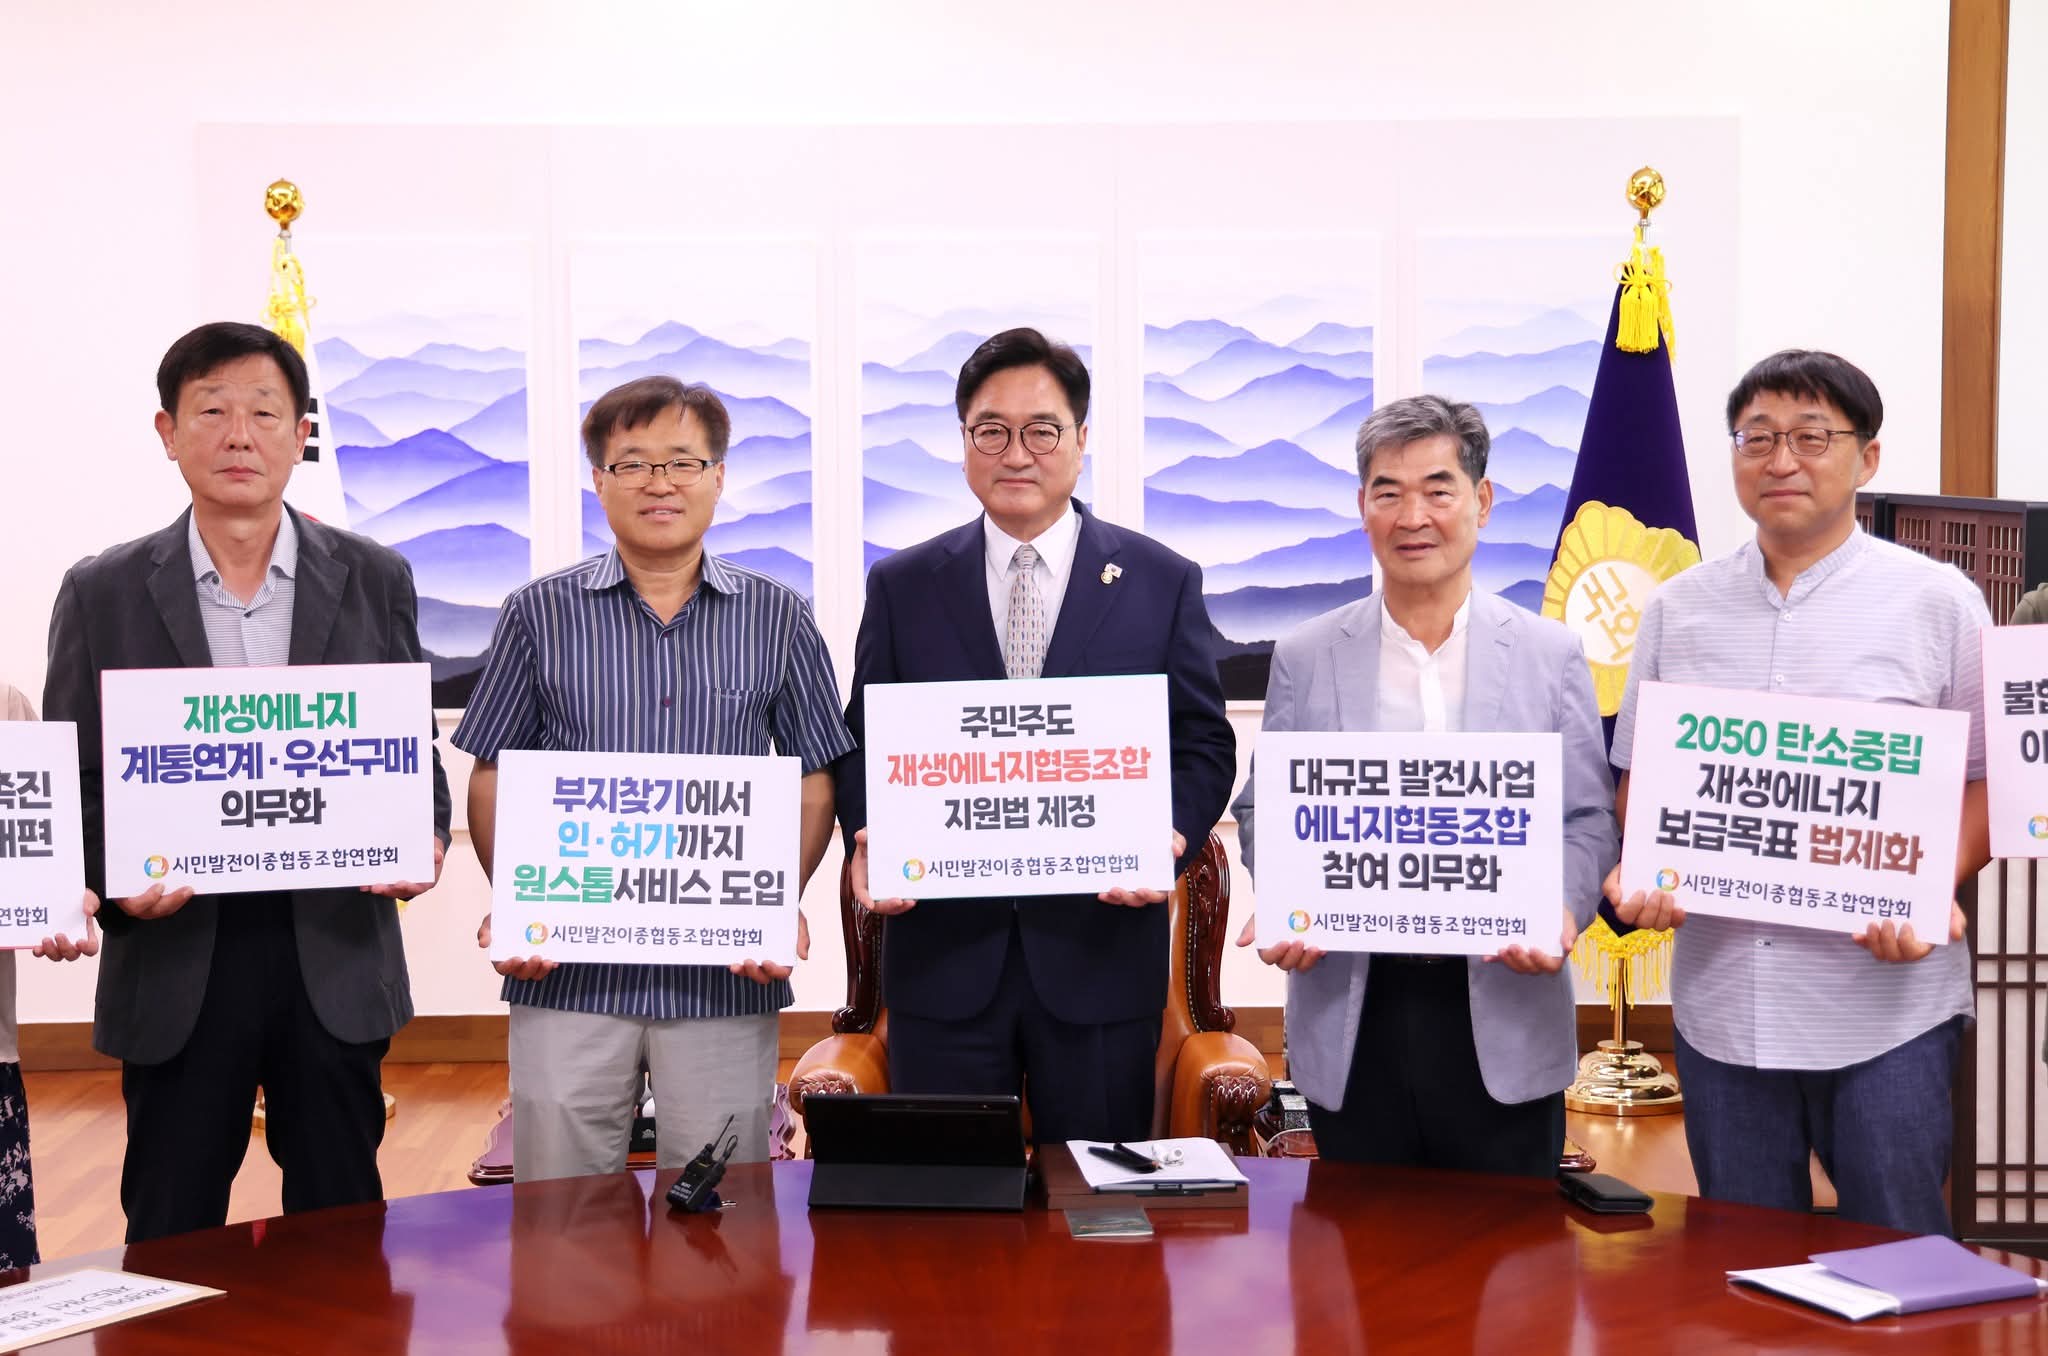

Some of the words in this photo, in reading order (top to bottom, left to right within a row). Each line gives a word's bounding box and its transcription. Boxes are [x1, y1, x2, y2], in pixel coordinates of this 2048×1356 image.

[184, 691, 357, 733] 재생에너지
[961, 704, 1074, 738] 주민주도
[1675, 713, 1767, 757] 2050
[1775, 722, 1923, 775] 탄소중립
[888, 747, 1150, 786] 재생에너지협동조합
[1290, 759, 1390, 796] 대규모
[1399, 760, 1534, 798] 발전사업
[221, 787, 326, 827] 의무화
[553, 777, 751, 816] 부지찾기에서
[1697, 763, 1881, 820] 재생에너지
[945, 797, 1029, 830] 지원법
[1037, 795, 1095, 828] 제정
[1295, 805, 1531, 846] 에너지협동조합
[1656, 806, 1798, 860] 보급목표
[1810, 824, 1923, 875] 법제화
[173, 846, 399, 875] 시민발전이종협동조합연합회
[929, 855, 1139, 879] 시민발전이종협동조합연합회
[1323, 851, 1388, 890] 참여
[1398, 853, 1502, 892] 의무화
[514, 865, 711, 904] 원스톱서비스
[720, 870, 784, 906] 도입
[1682, 874, 1913, 919] 시민발전이종협동조합연합회
[552, 925, 763, 947] 시민발전이종협동조합연합회
[1314, 913, 1526, 937] 시민발전이종협동조합연합회
